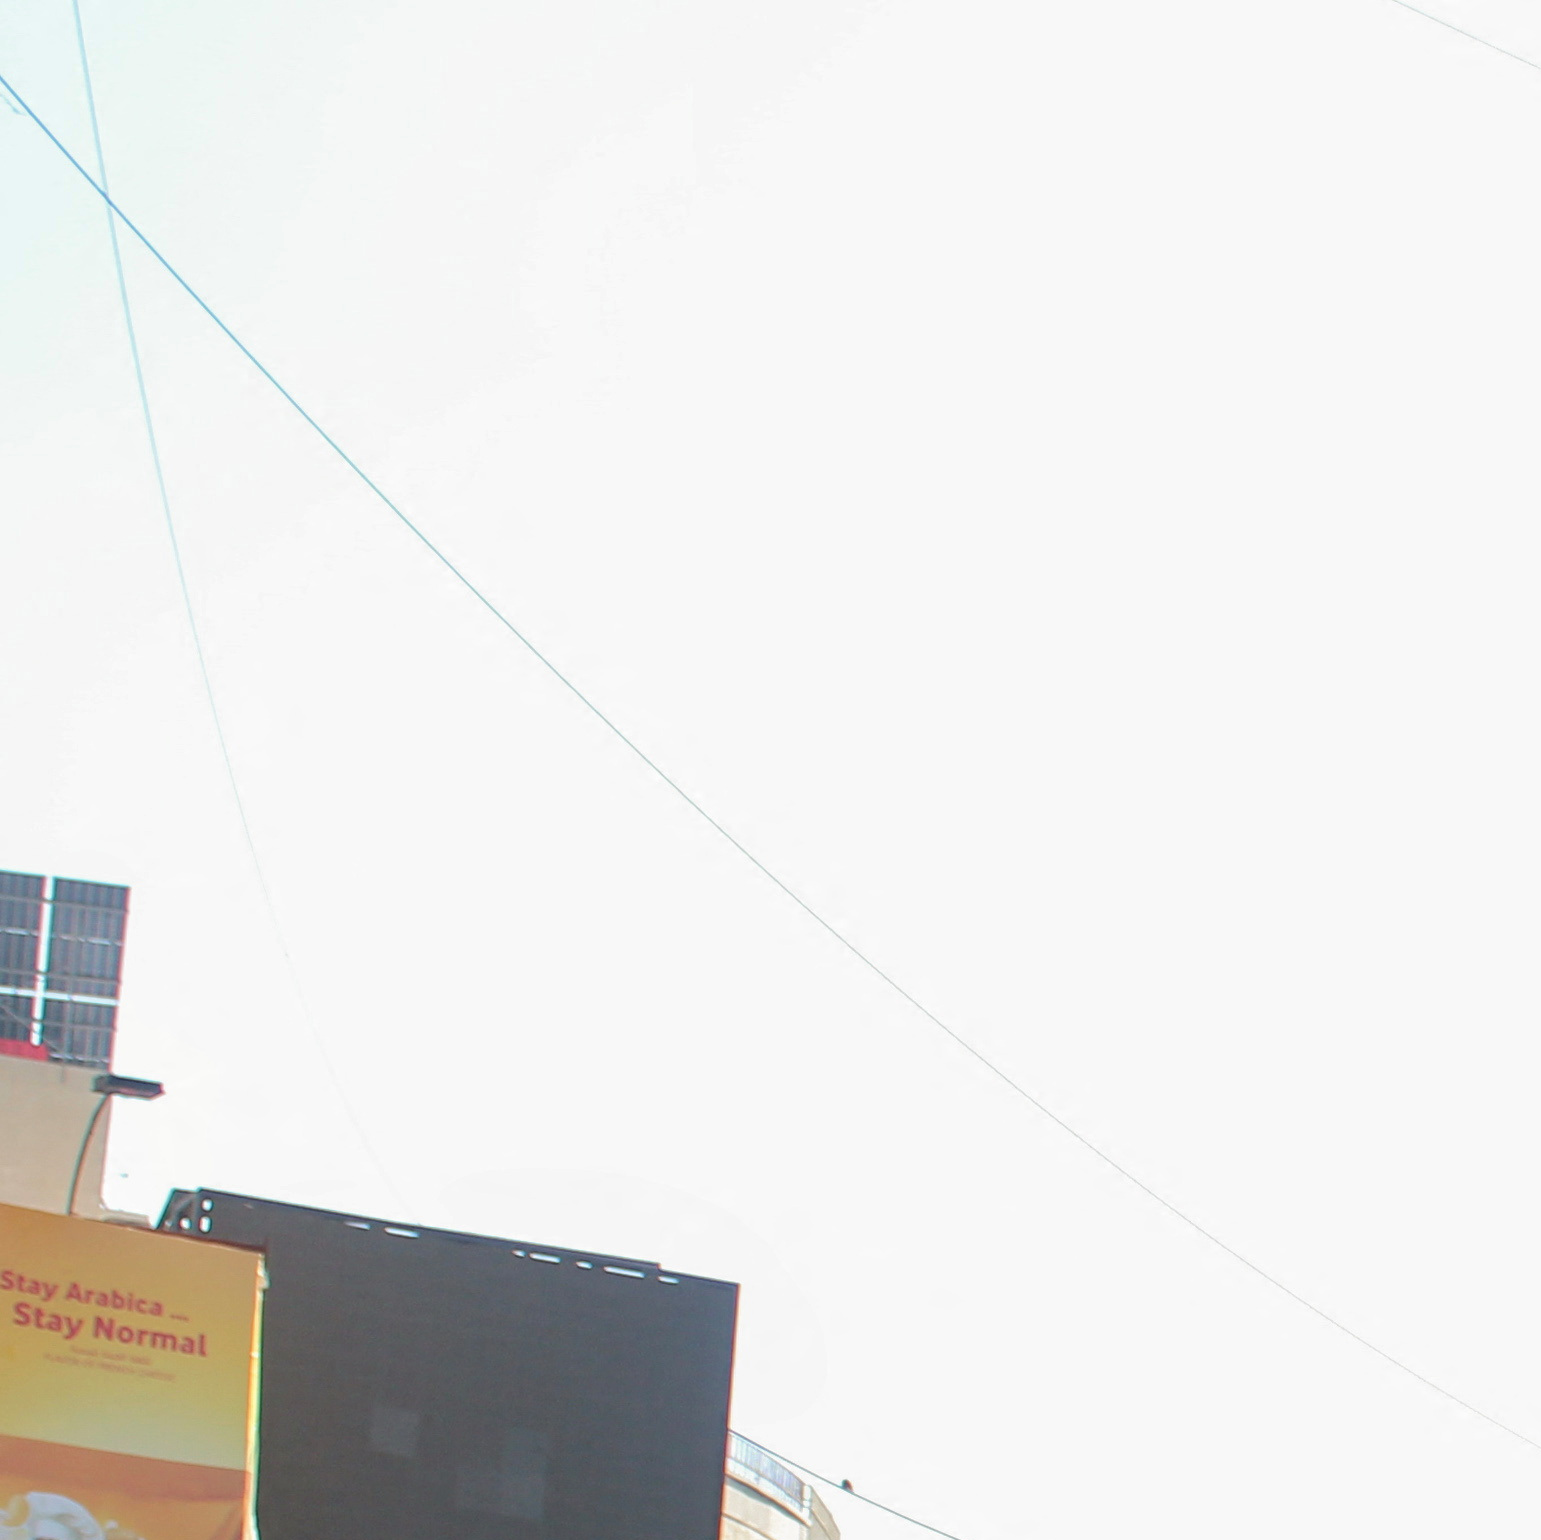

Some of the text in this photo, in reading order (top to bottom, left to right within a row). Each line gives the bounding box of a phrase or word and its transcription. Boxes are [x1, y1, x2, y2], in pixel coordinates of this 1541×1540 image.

[0, 1270, 59, 1301] Stay
[66, 1282, 164, 1317] Arabica
[13, 1302, 207, 1358] Stay Normal
